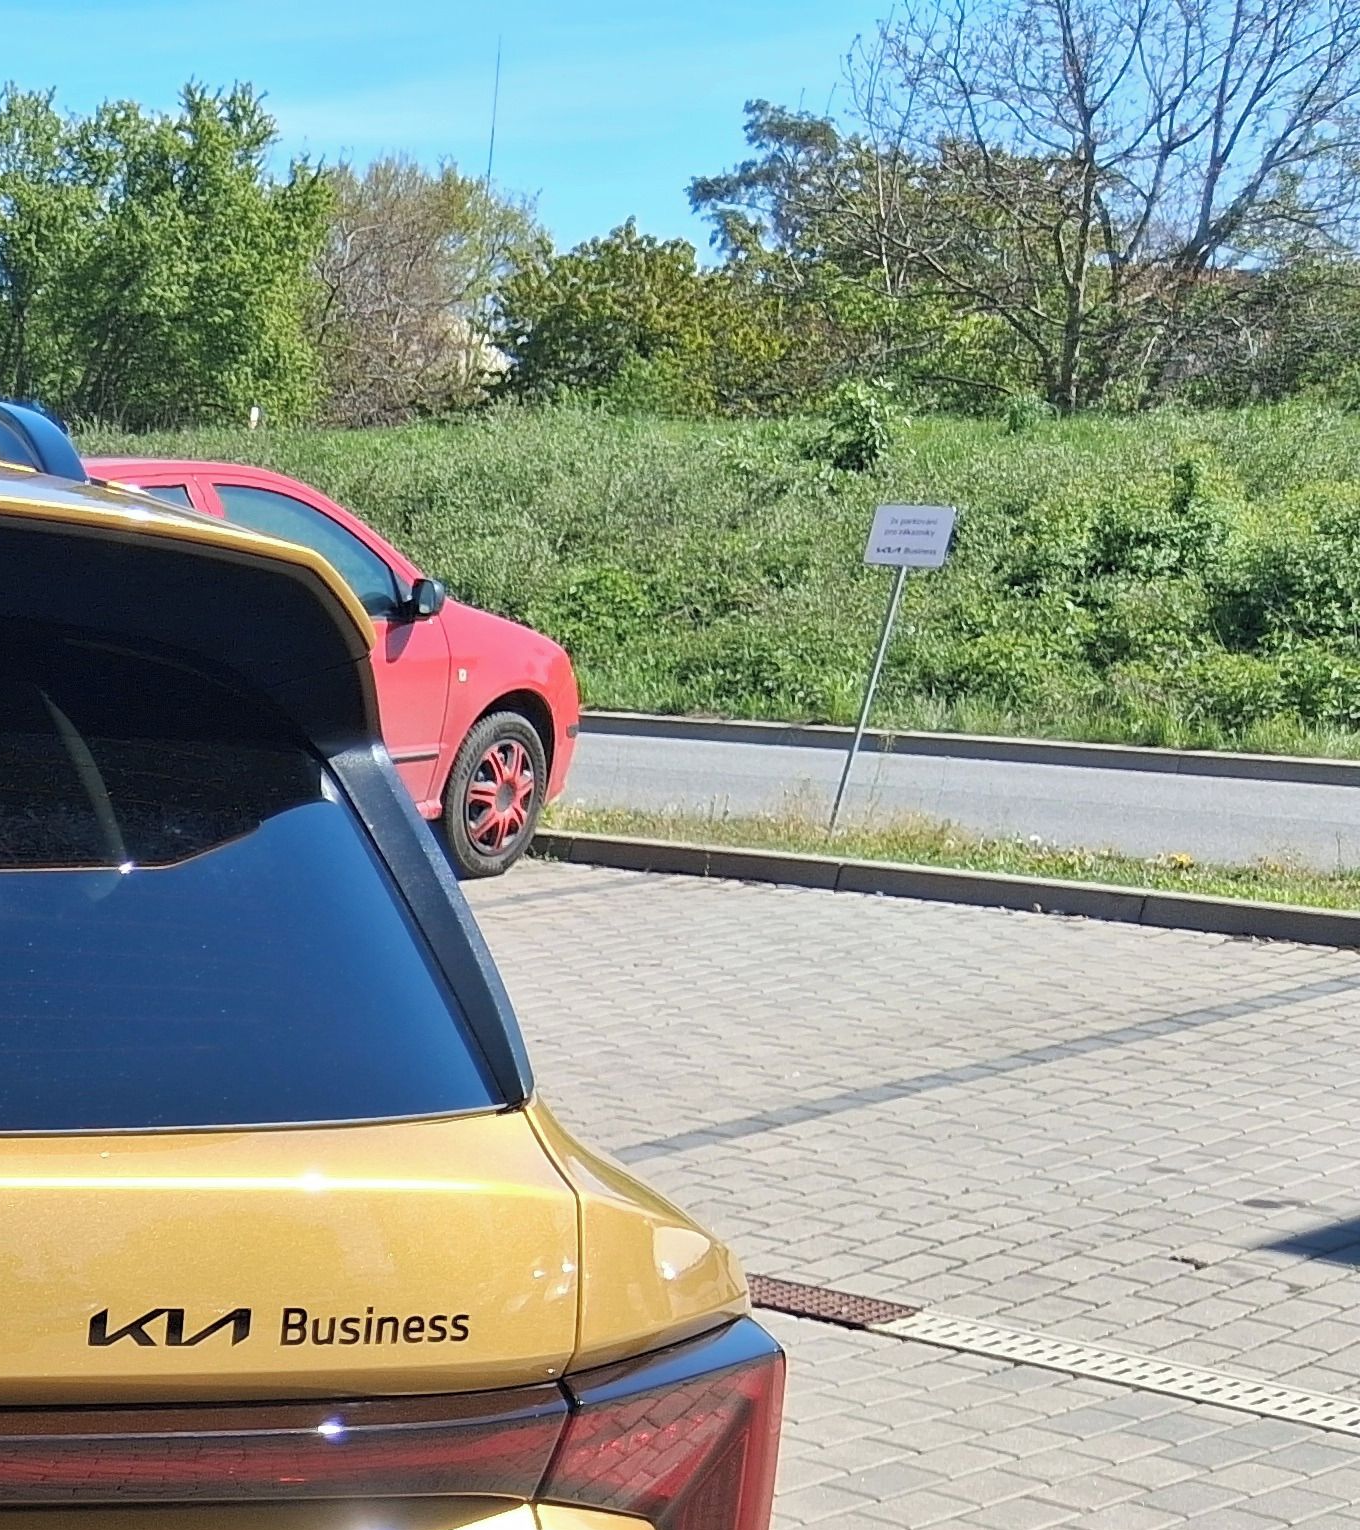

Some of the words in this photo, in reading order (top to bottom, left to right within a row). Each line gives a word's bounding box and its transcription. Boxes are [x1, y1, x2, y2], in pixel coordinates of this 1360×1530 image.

[903, 546, 937, 555] Business
[88, 1308, 252, 1347] KIA
[280, 1306, 470, 1346] Business
